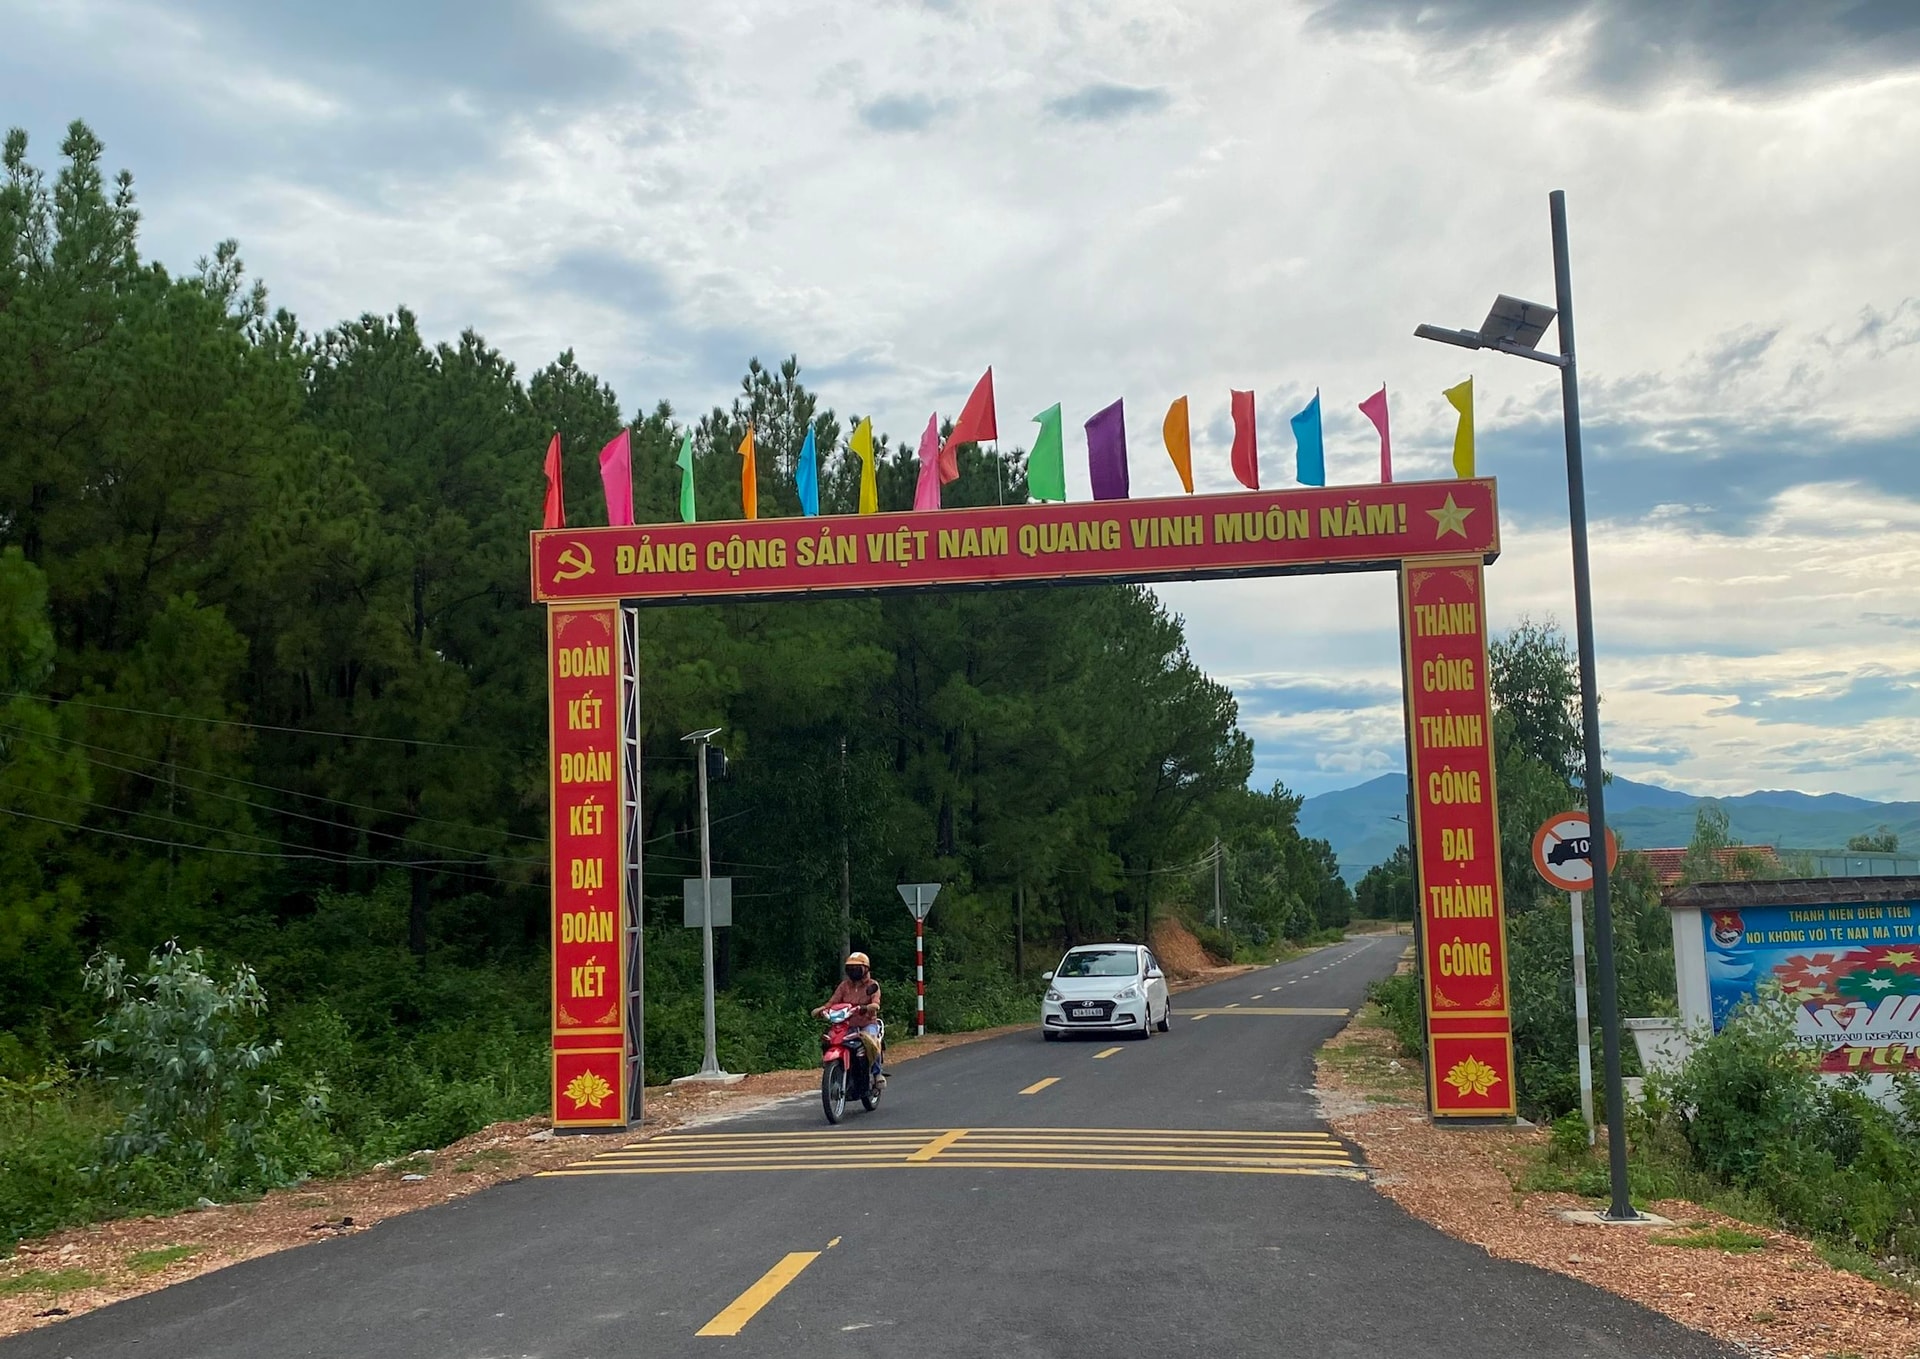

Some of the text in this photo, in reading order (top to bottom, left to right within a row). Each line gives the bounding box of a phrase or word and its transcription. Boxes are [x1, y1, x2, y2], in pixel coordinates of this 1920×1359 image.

[616, 499, 1407, 576] ĐẢNG CỘNG SẢN VIỆT NAM QUANG VINH MUÔN NĂM!
[1414, 597, 1477, 636] THÀNH
[558, 641, 610, 678] ĐOÀN
[1422, 653, 1475, 692] CÔNG
[568, 690, 602, 730] KẾT
[1420, 708, 1483, 748] THÀNH
[560, 746, 612, 783] ĐOÀN
[1428, 765, 1481, 804] CÔNG
[570, 795, 604, 835] KẾT
[1441, 828, 1474, 868] ĐẠI
[571, 858, 603, 895] ĐẠI
[1429, 879, 1494, 918] THÀNH
[561, 905, 613, 943] ĐOÀN
[1439, 937, 1492, 976] CÔNG
[571, 955, 606, 998] KẾT
[1816, 1032, 1863, 1041] NHAU
